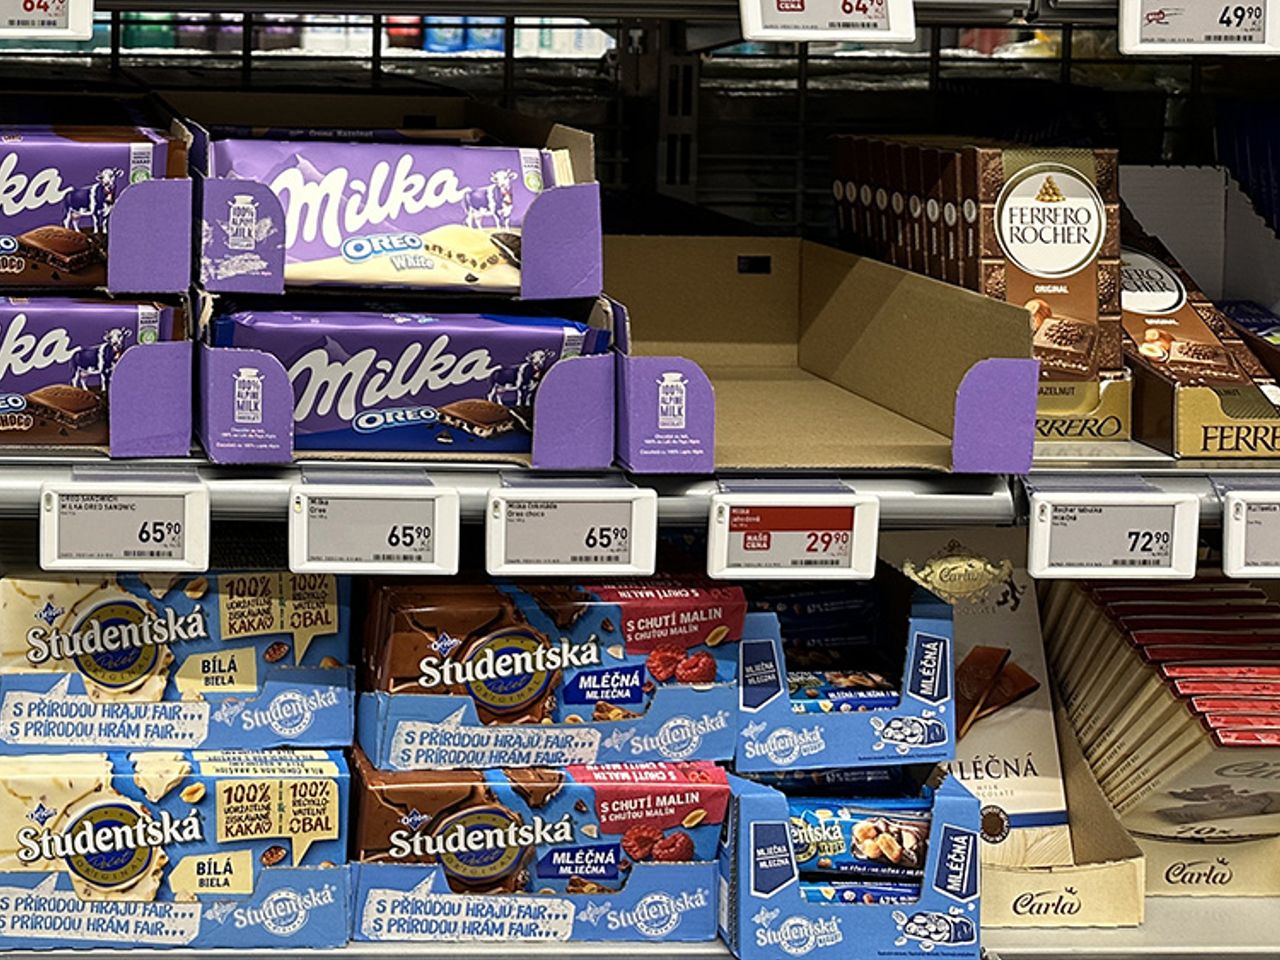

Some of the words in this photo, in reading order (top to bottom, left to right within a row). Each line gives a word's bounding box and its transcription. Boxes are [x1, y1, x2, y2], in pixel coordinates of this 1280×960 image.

[267, 154, 471, 249] Milka
[1008, 207, 1091, 225] FERRERO
[346, 234, 421, 258] OREO
[1009, 226, 1091, 244] ROCHER
[391, 255, 434, 270] White
[1035, 285, 1069, 294] ORIGINAL
[288, 335, 503, 422] Milka
[358, 408, 436, 429] OREO
[1201, 425, 1280, 451] FERRE
[627, 621, 634, 631] S
[637, 611, 676, 630] CHUTÍ
[680, 607, 722, 624] MALIN
[26, 605, 208, 662] Studentská
[201, 651, 238, 673] BÍLÁ
[418, 634, 599, 688] Studentská
[919, 642, 938, 695] MLÉČNÁ
[204, 675, 235, 686] BIELA
[579, 670, 640, 688] MLÉČNÁ
[586, 689, 631, 699] MLIEČNA
[18, 809, 203, 861] Studentská
[389, 814, 573, 858] Studentská
[196, 853, 233, 875] BÍLÁ
[552, 850, 615, 865] MLÉČNÁ
[946, 835, 968, 891] MLÉČNÁ
[1165, 857, 1233, 885] Carla
[1012, 886, 1081, 916] Carla
